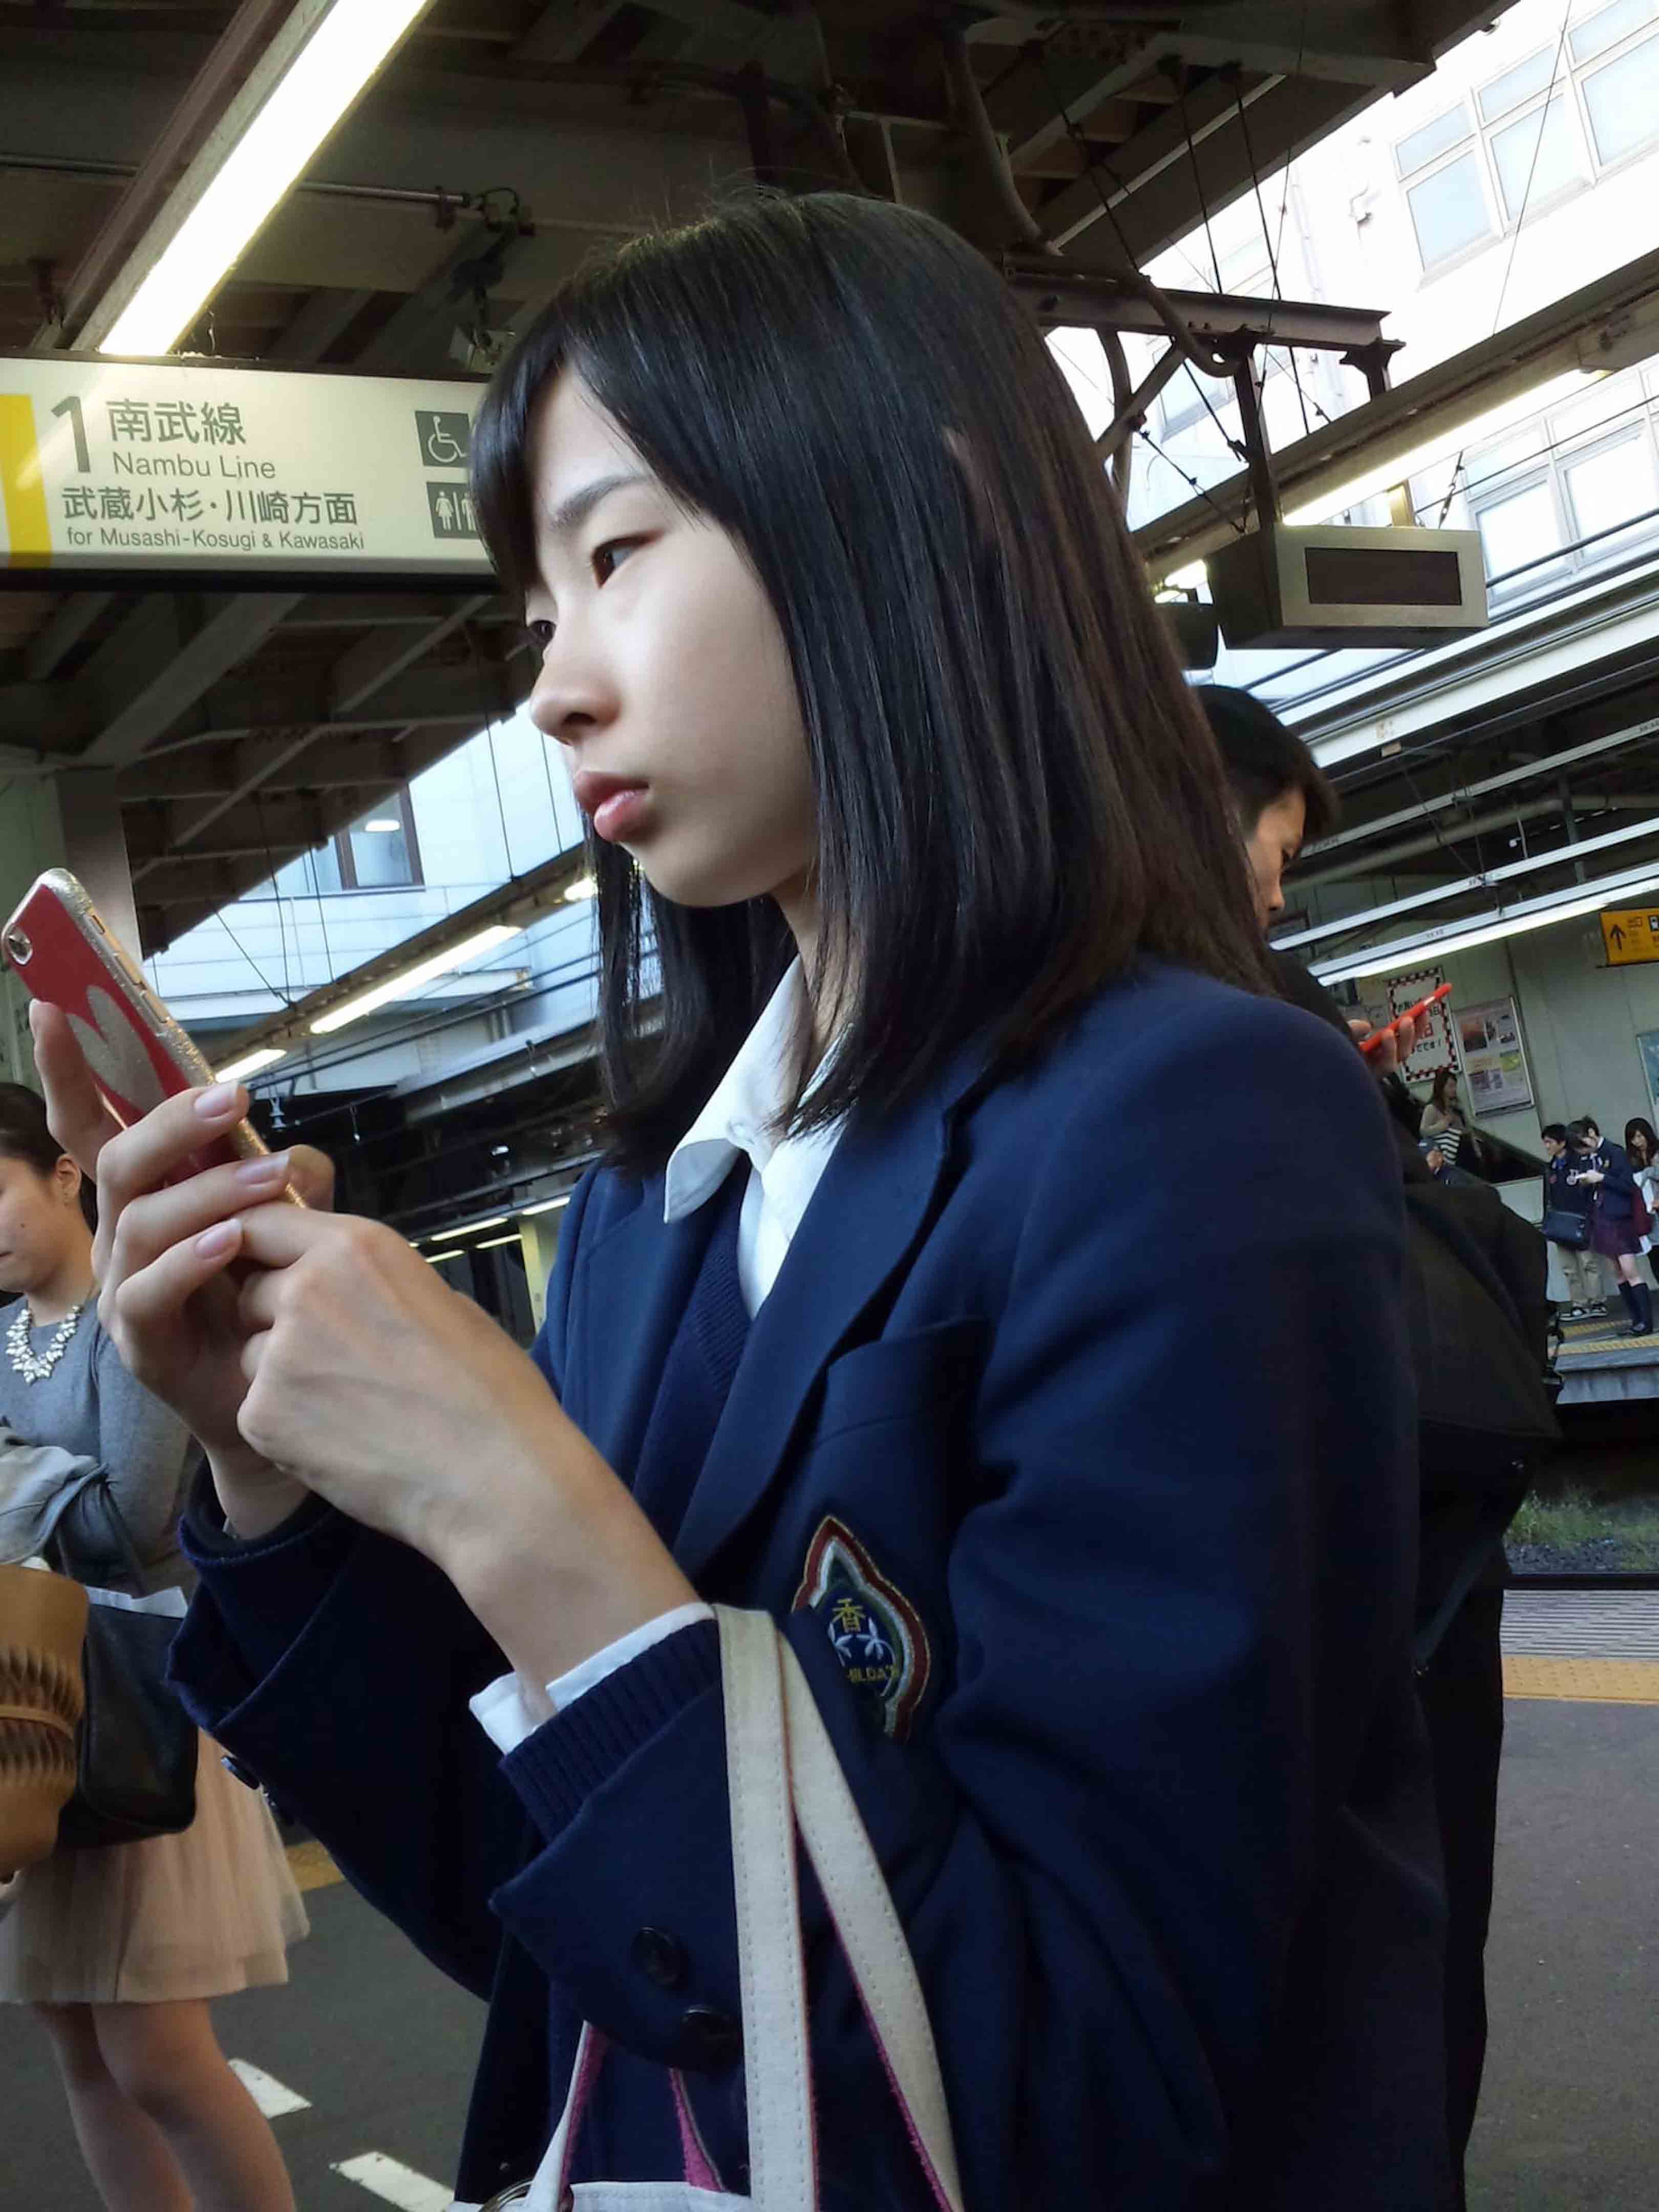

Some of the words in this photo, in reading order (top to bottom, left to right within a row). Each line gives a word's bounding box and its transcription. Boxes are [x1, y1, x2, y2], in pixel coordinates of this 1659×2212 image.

[51, 396, 91, 473] 1
[106, 398, 246, 445] 南武線
[112, 451, 211, 477] Nambu
[220, 455, 276, 479] Line
[67, 527, 93, 545] for
[100, 527, 257, 551] Musashi-Kosugi
[262, 533, 272, 548] &
[279, 530, 365, 550] Kawasaki
